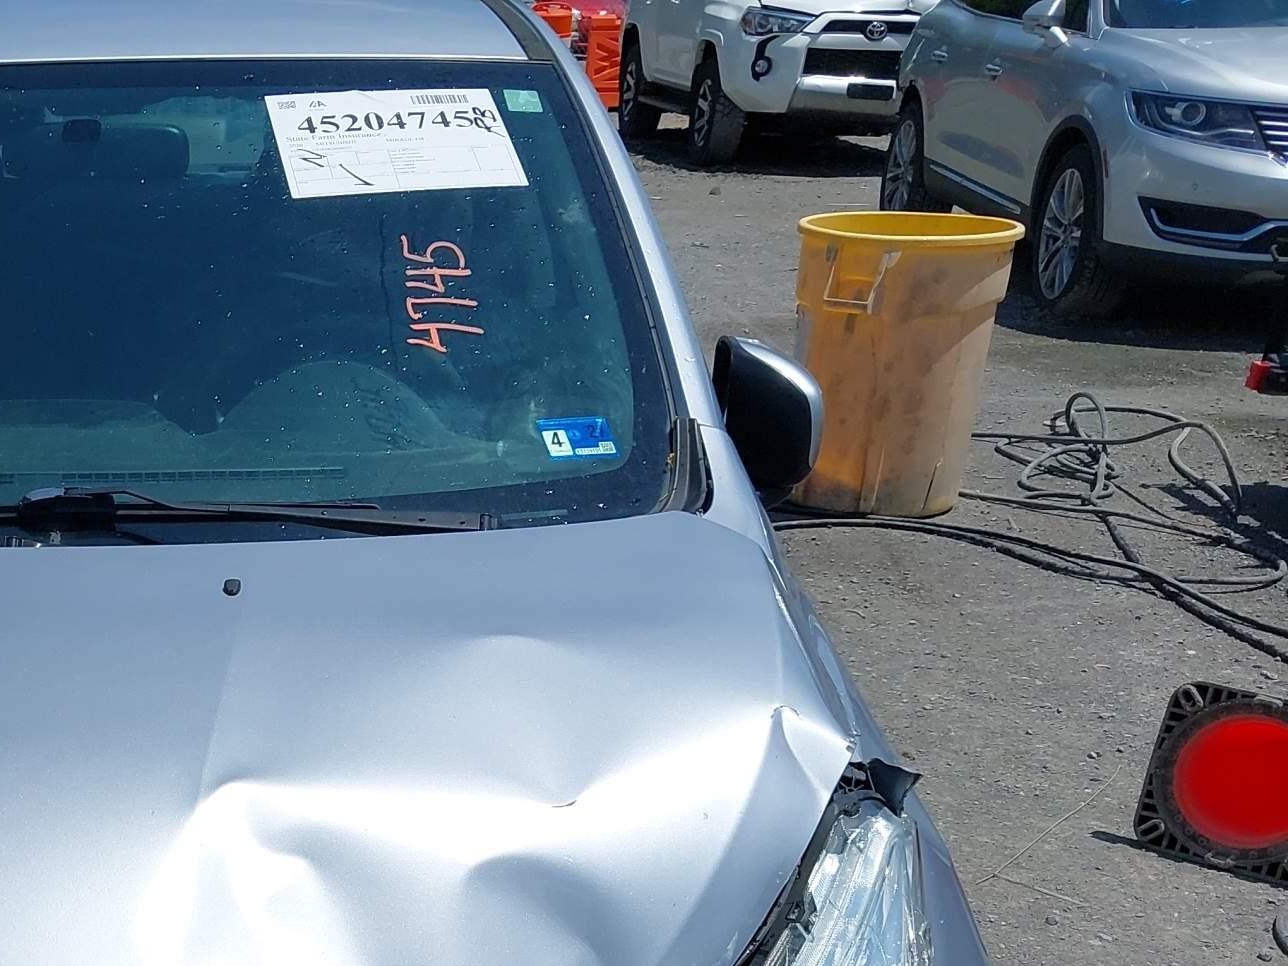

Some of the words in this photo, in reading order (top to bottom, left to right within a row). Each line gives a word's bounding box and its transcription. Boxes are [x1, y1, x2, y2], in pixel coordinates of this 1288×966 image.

[297, 111, 474, 134] 45204745
[400, 234, 484, 353] 4745
[551, 431, 565, 448] 4
